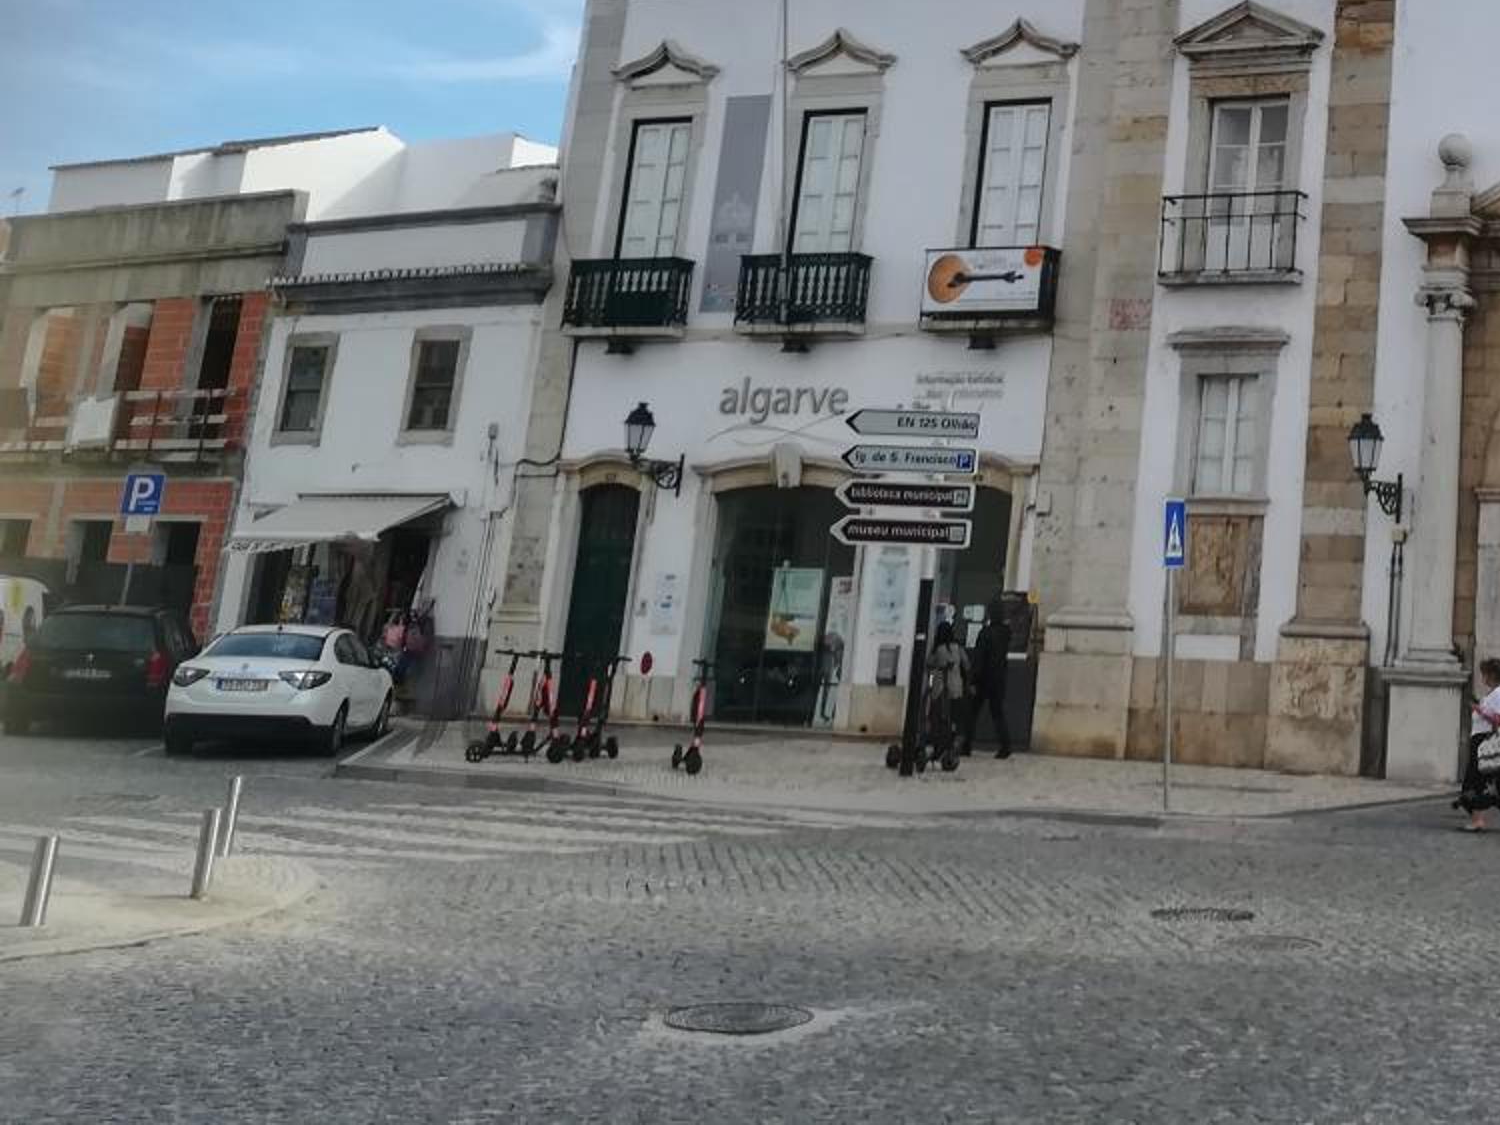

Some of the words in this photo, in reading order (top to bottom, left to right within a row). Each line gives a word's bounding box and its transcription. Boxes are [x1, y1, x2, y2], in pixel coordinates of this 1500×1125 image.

[719, 376, 849, 425] algarve
[897, 417, 915, 428] EN
[919, 418, 938, 428] 125
[903, 453, 957, 466] Francisco
[128, 477, 155, 512] P
[850, 486, 901, 500] biblioteca
[902, 490, 953, 505] municipal
[848, 525, 890, 537] museu
[891, 527, 950, 540] municipal
